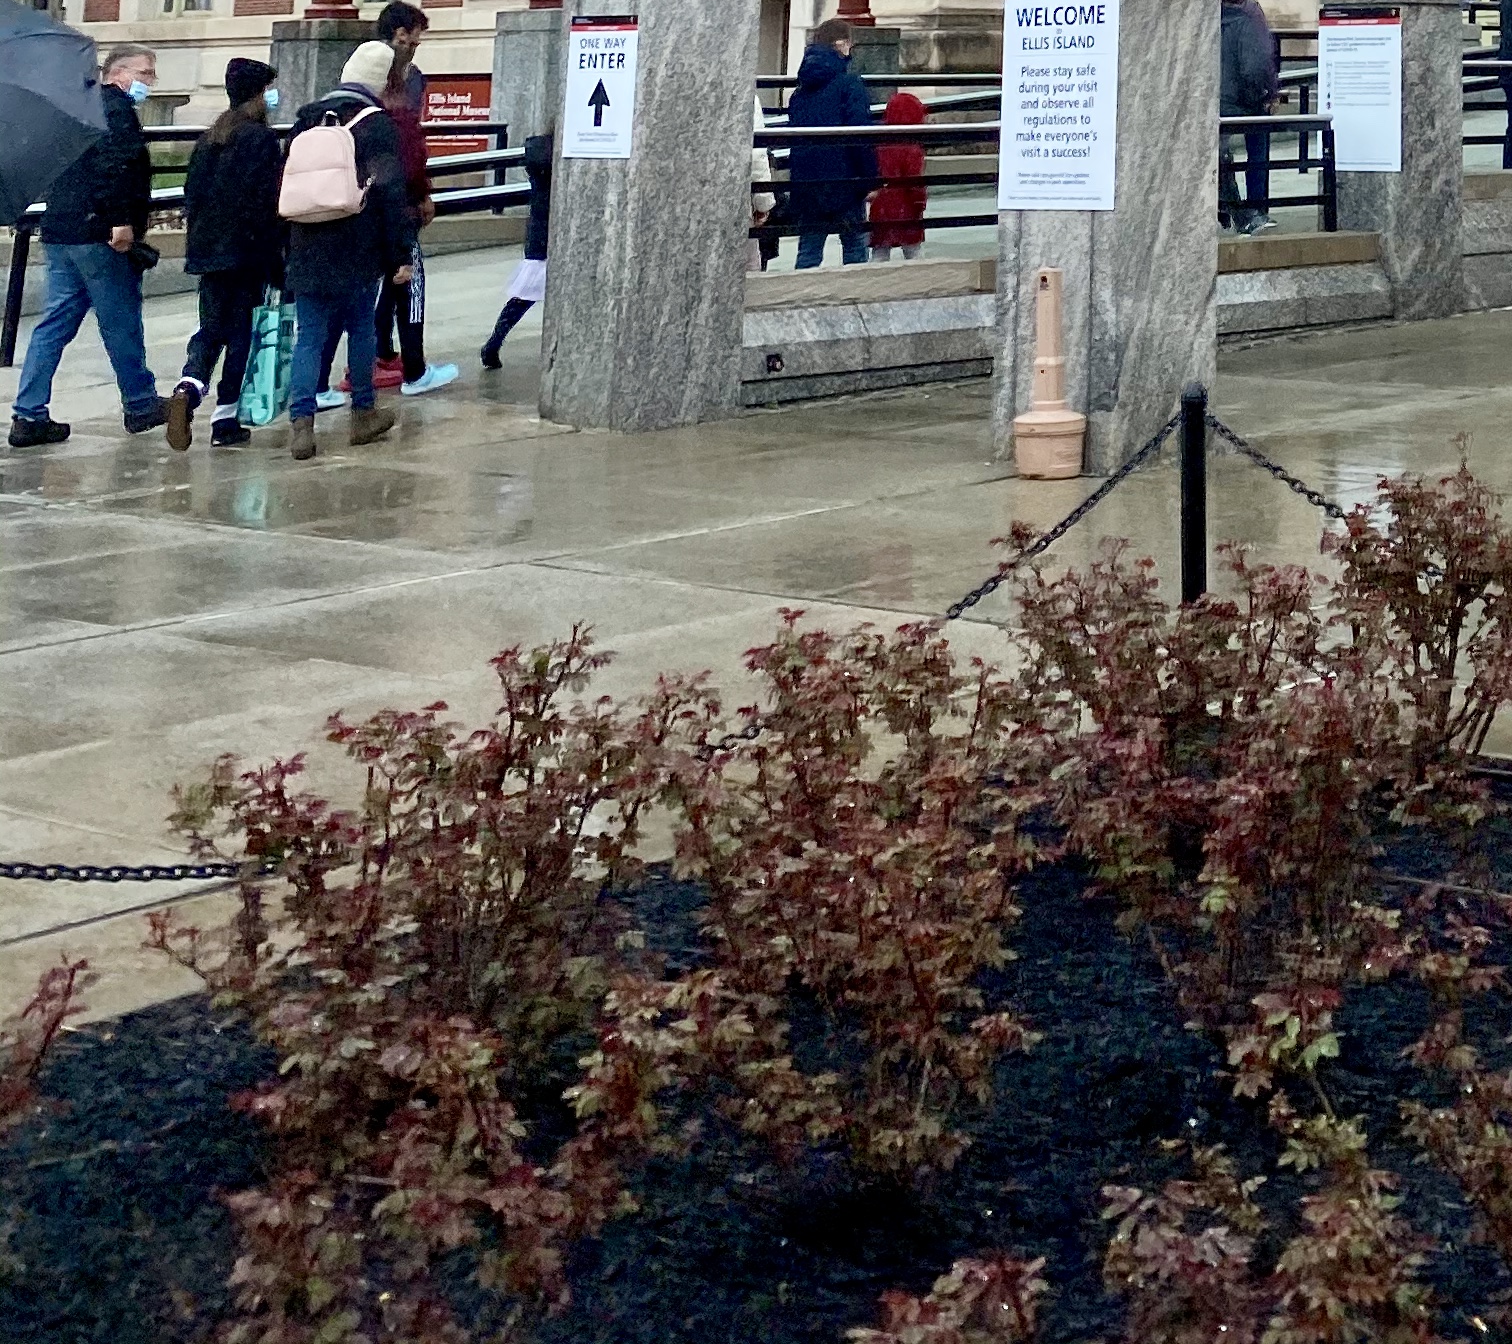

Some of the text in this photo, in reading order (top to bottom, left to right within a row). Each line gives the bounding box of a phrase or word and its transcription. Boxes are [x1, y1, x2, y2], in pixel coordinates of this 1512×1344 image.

[1016, 4, 1105, 27] WELCOME
[580, 37, 626, 49] ONE WAY
[1022, 35, 1095, 50] ELLIS ISLAND
[579, 53, 625, 69] ENTER
[1020, 63, 1096, 79] Please stay safe
[1018, 80, 1098, 96] during your visit
[1020, 96, 1094, 109] and observe all
[1023, 113, 1091, 128] regulations to
[1016, 129, 1097, 144] make everyone's
[1021, 146, 1091, 158] visit a success!
